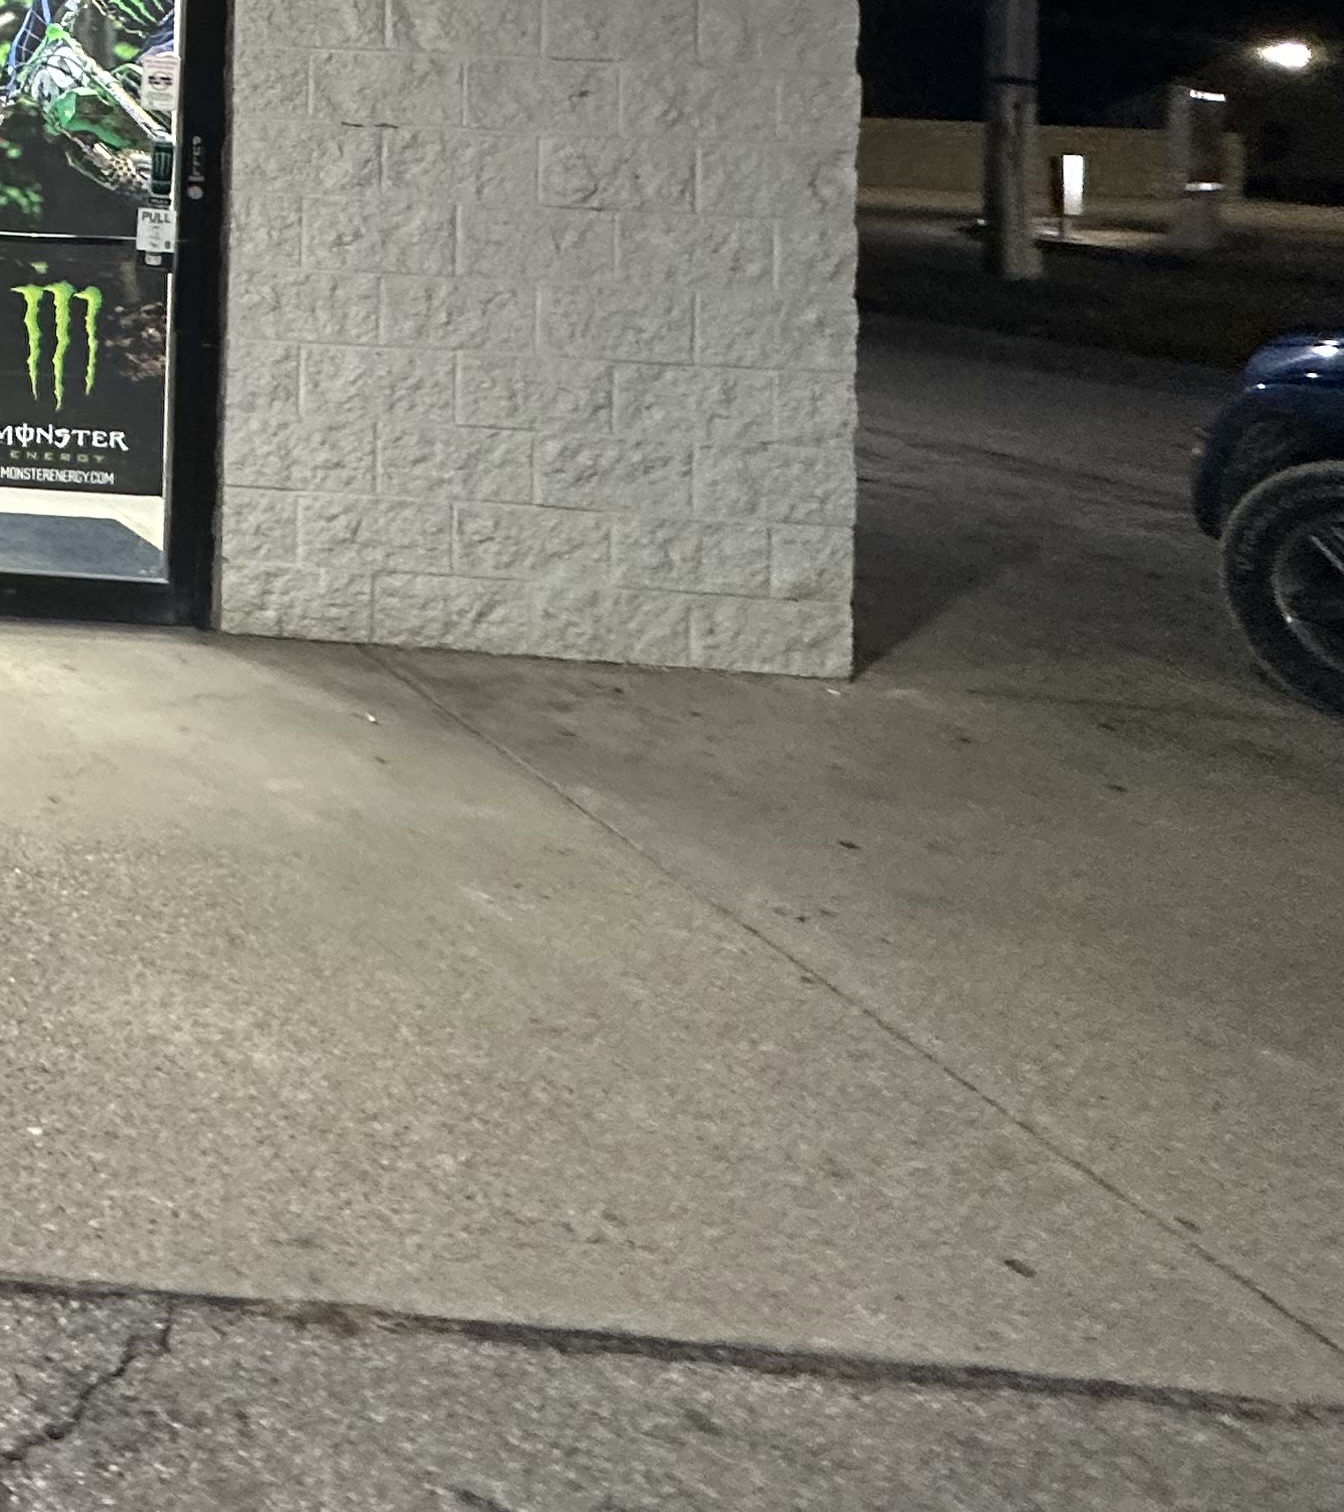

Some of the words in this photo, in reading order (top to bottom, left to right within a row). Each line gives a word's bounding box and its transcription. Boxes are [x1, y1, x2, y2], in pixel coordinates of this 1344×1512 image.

[141, 211, 171, 224] PULL
[9, 449, 106, 463] ENERGY
[0, 465, 116, 486] MONSTERENERGY.COM
